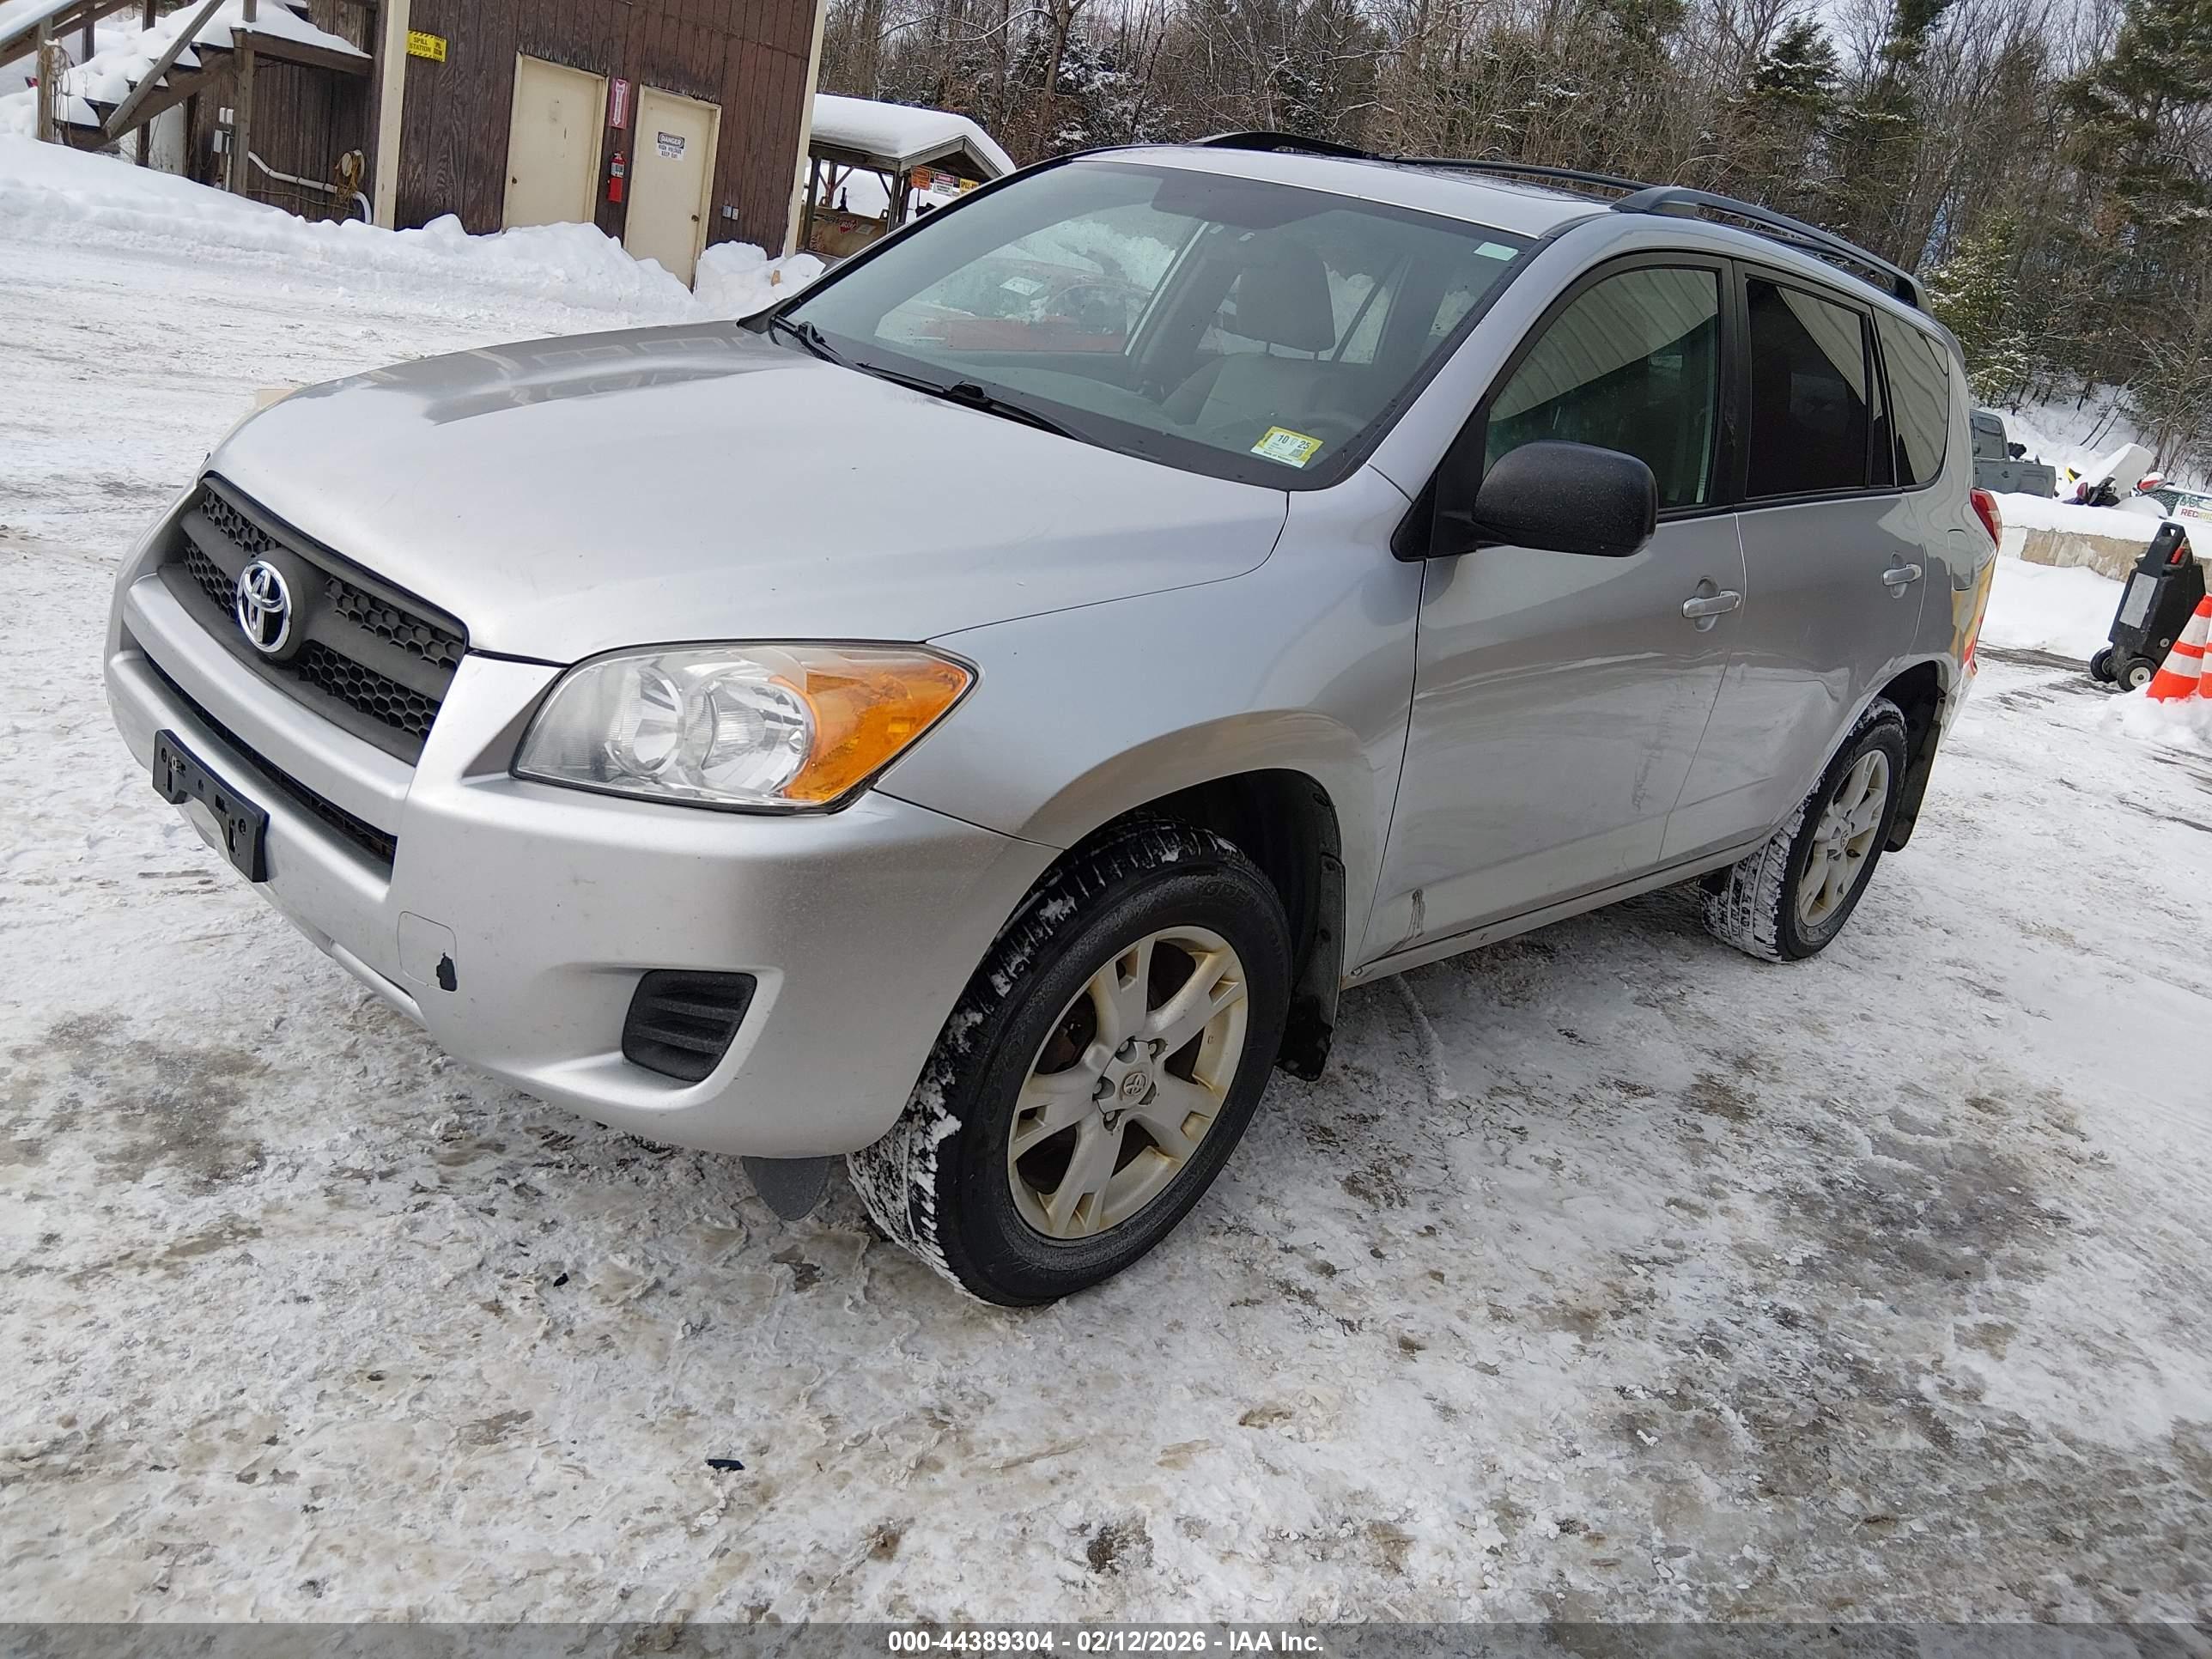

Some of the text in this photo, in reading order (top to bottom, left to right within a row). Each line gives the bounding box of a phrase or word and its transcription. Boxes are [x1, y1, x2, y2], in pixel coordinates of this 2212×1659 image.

[409, 43, 431, 52] STATION
[660, 135, 682, 145] DANGER
[1278, 434, 1311, 449] 10 25
